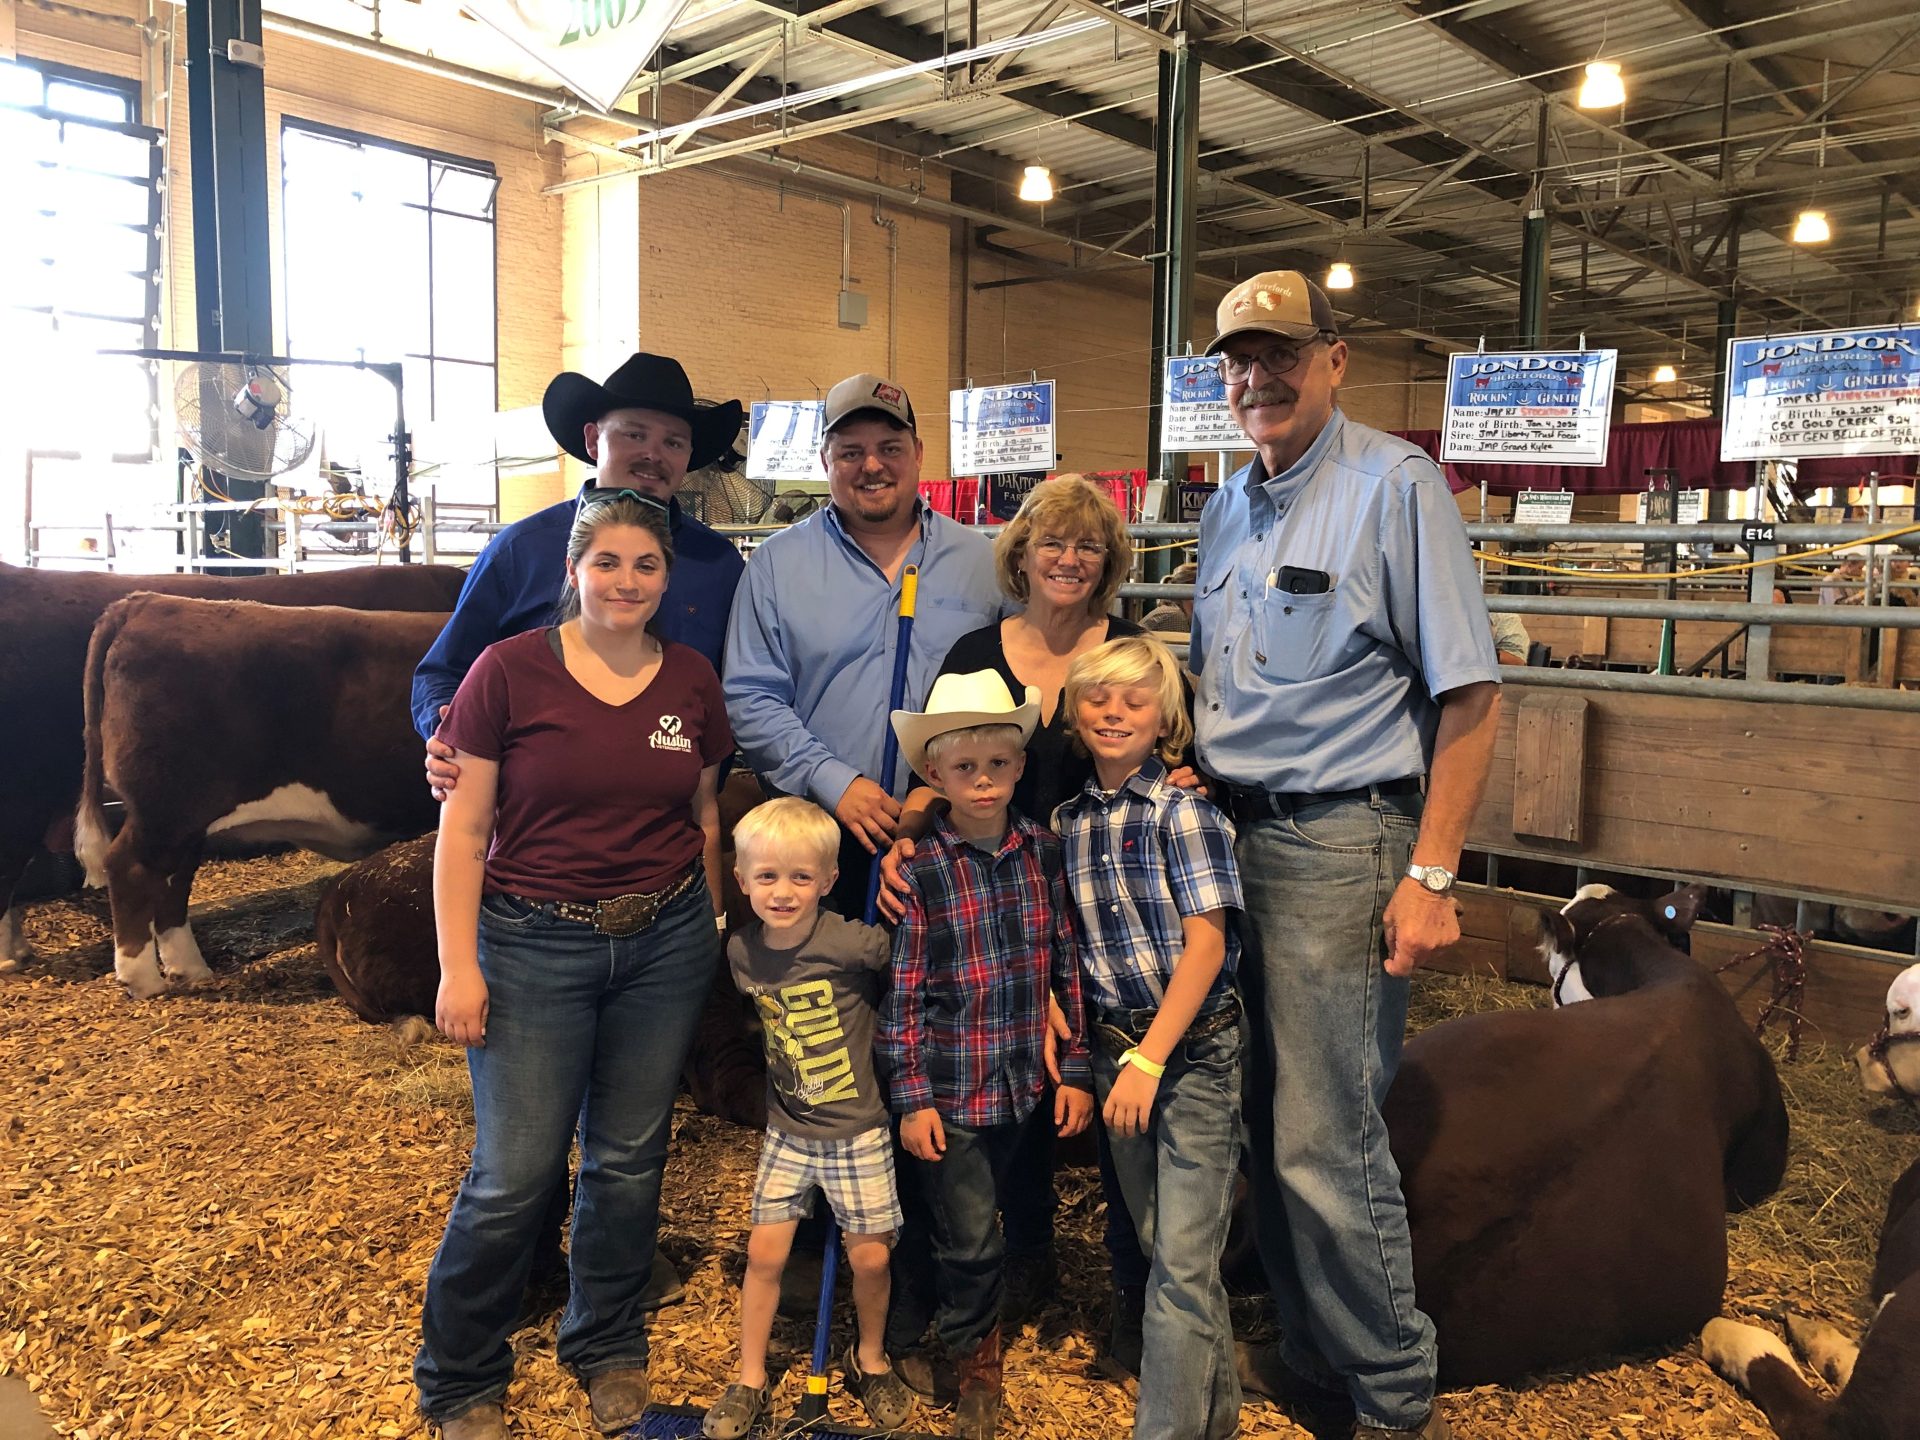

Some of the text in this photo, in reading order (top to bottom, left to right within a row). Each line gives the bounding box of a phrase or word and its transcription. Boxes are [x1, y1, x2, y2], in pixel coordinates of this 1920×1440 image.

[1174, 361, 1219, 380] JON
[1170, 404, 1193, 412] Name:
[1453, 408, 1483, 417] Name:
[1169, 414, 1187, 422] Date
[1201, 412, 1223, 421] Birth:
[1452, 420, 1523, 429] Date of Birth:
[1802, 419, 1833, 429] GOLD
[1838, 416, 1878, 428] CREEK
[1168, 424, 1187, 432] Sire:
[1167, 434, 1188, 442] Dam:
[1451, 430, 1475, 440] Sire:
[1501, 430, 1529, 439] Liberty
[1531, 430, 1554, 439] Trust
[1770, 431, 1801, 445] NEXT
[1803, 431, 1829, 443] GEN
[1832, 429, 1868, 441] BELLE
[1871, 428, 1885, 438] OF
[1890, 428, 1912, 437] THE
[1450, 442, 1476, 451] Dam:
[1501, 441, 1527, 451] Grand
[1531, 442, 1553, 453] Kylee
[1746, 528, 1773, 541] E14
[648, 730, 692, 749] Austin
[780, 979, 860, 1106] GOLDY
